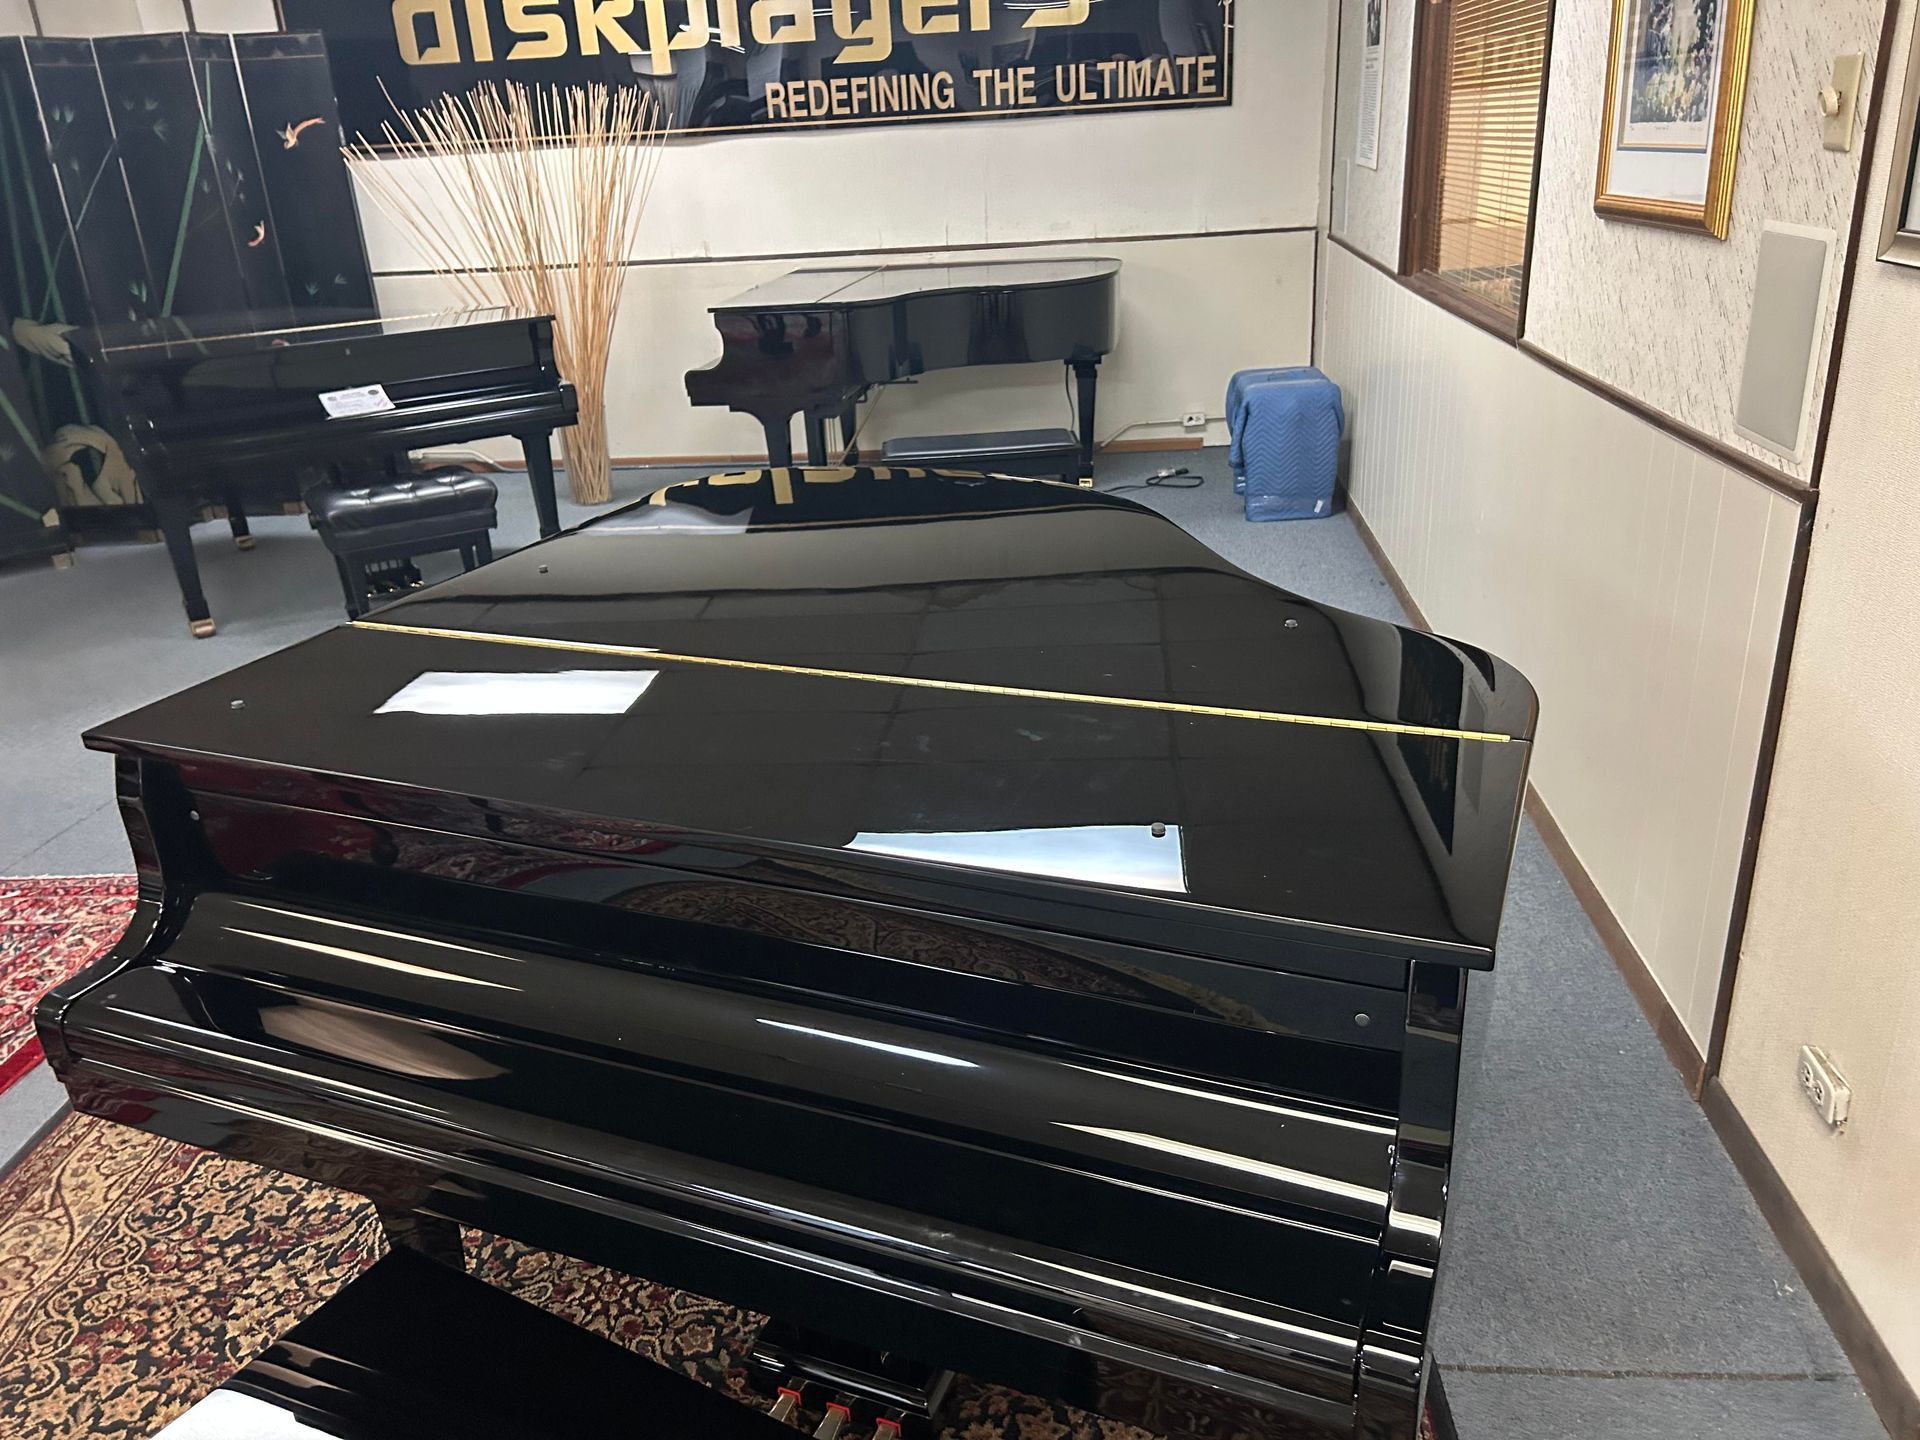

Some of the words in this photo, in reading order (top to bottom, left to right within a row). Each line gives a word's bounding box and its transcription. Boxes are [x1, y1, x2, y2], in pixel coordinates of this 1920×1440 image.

[765, 70, 954, 119] REDEFINING
[973, 66, 1037, 107] THE
[1055, 55, 1217, 103] ULTIMATE
